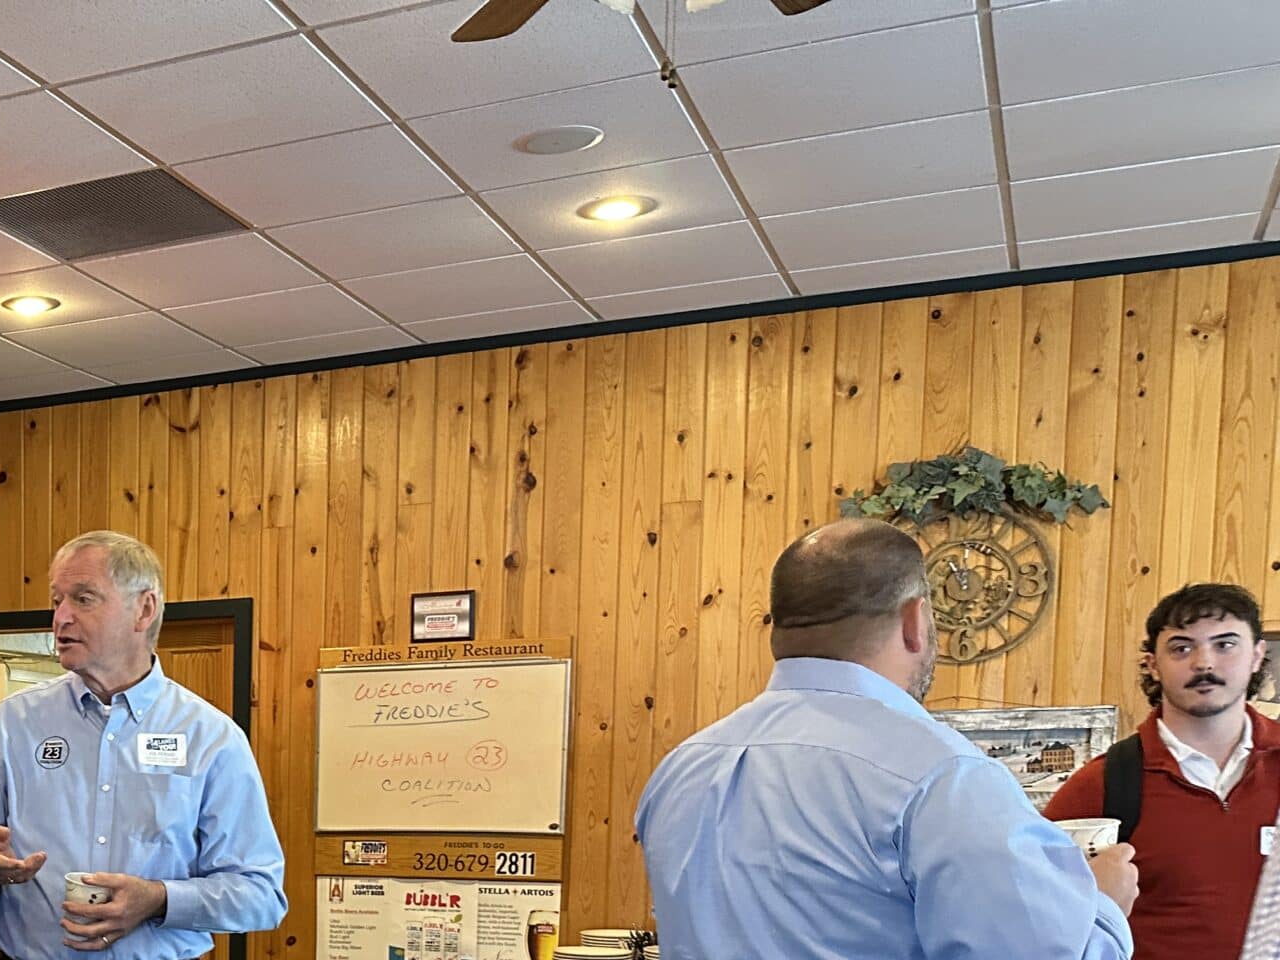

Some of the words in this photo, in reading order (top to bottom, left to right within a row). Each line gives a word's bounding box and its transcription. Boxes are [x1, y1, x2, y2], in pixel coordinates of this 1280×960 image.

[343, 649, 401, 663] Freddies
[408, 646, 457, 660] Family
[463, 643, 545, 657] Restaurant
[355, 679, 459, 701] WELCOME
[473, 677, 499, 689] TO
[373, 699, 490, 723] FREDDIE'S
[45, 747, 60, 759] 23
[350, 751, 450, 770] HIGHWAY
[472, 745, 504, 766] 23
[381, 778, 493, 793] COALITION
[478, 887, 510, 895] STELLA
[520, 889, 554, 897] ARTOIS
